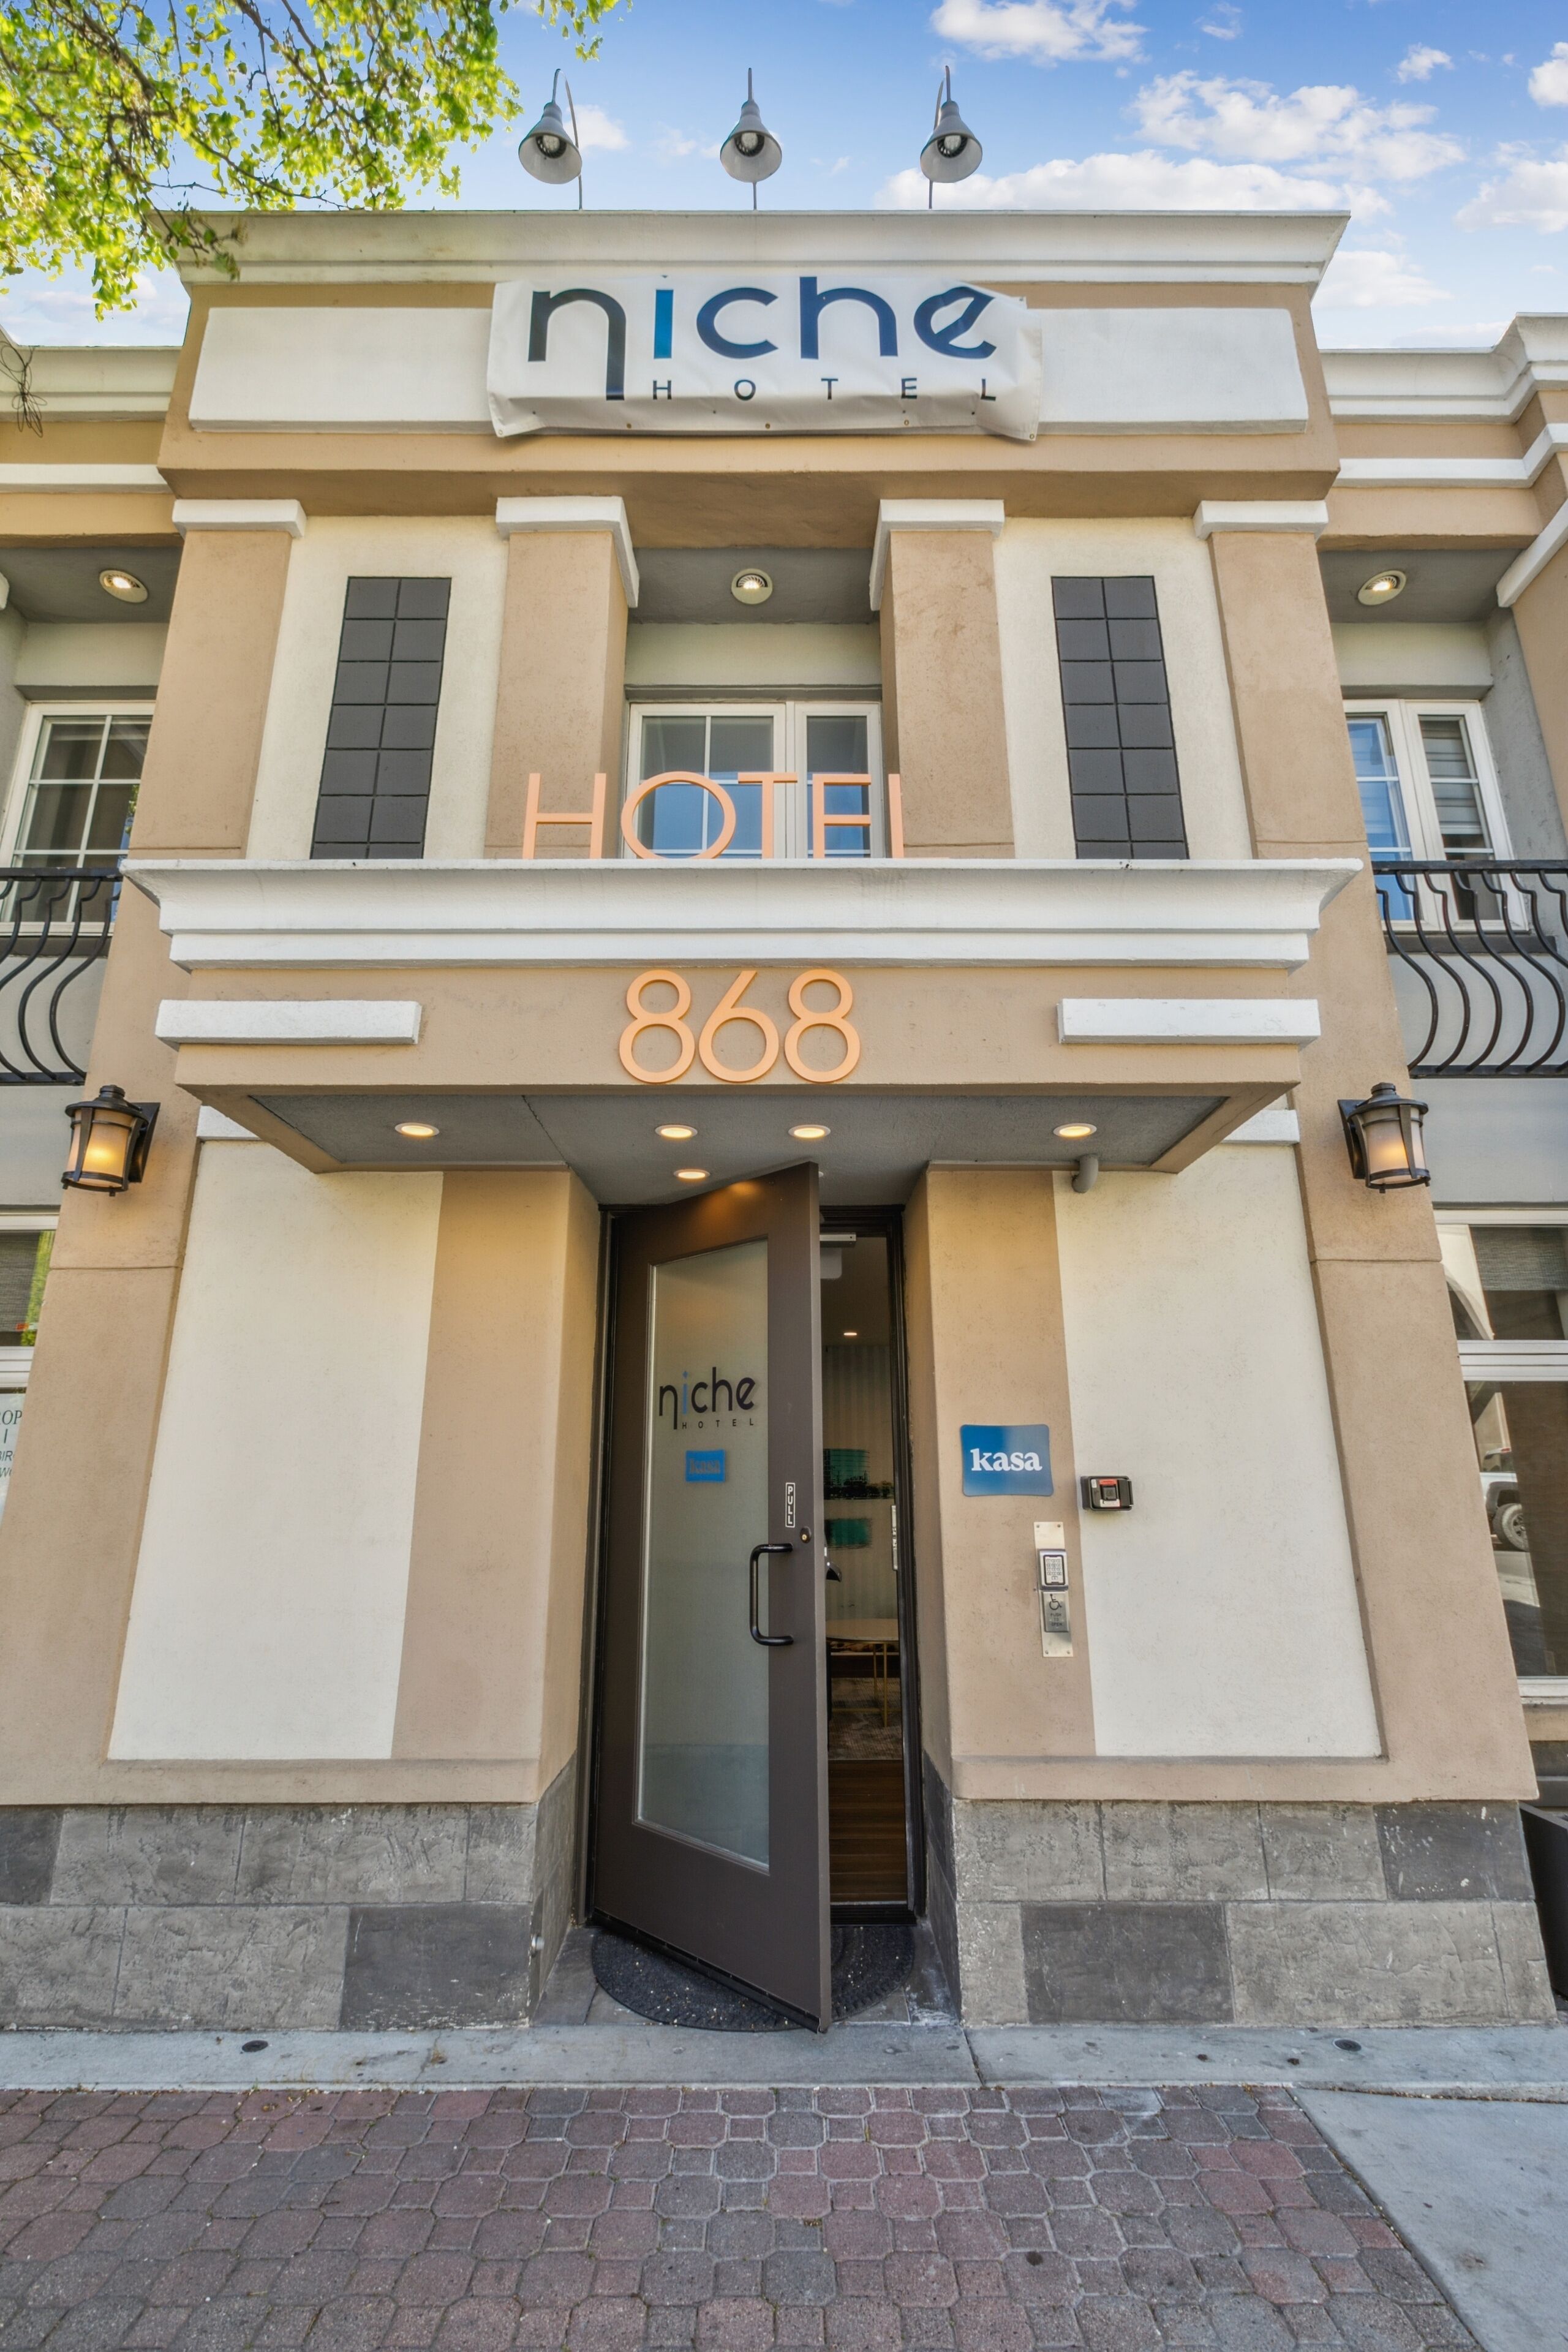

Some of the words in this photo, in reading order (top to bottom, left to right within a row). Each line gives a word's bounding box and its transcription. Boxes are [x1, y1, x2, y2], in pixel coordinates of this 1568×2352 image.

[527, 276, 997, 401] niche
[652, 377, 997, 402] HOTEL
[619, 969, 861, 1084] 868
[658, 1366, 756, 1430] niche
[0, 1409, 23, 1425] OP
[682, 1418, 754, 1430] HOTEL
[970, 1447, 1043, 1471] kasa
